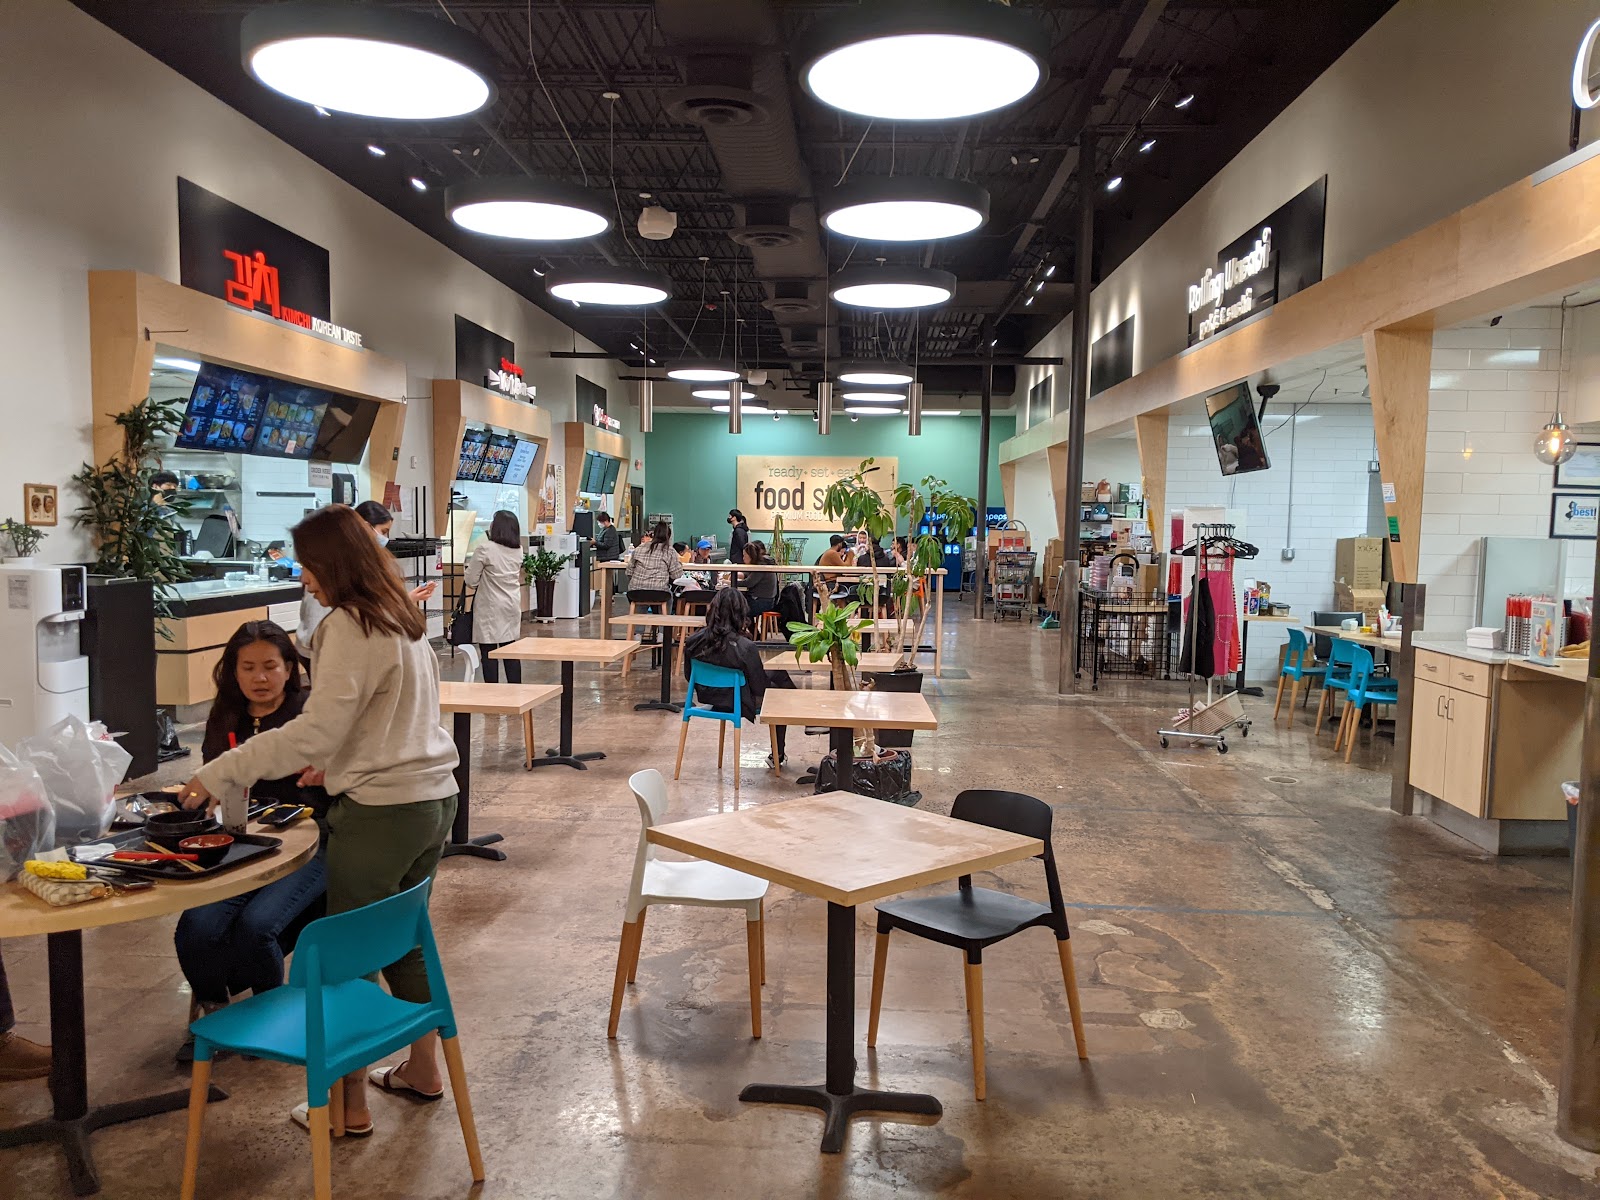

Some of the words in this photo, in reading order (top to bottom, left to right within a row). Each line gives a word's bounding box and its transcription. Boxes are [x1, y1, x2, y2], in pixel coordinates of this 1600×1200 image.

[223, 249, 281, 318] 김치
[1189, 268, 1224, 313] Rolling
[1225, 227, 1271, 290] Wasabi
[281, 306, 311, 330] KIMCHI
[311, 316, 341, 341] KOREAN
[341, 327, 362, 347] TASTE
[768, 465, 803, 480] ready
[811, 466, 829, 478] set
[837, 466, 855, 478] eat
[754, 480, 805, 510] food
[988, 513, 1007, 521] peps
